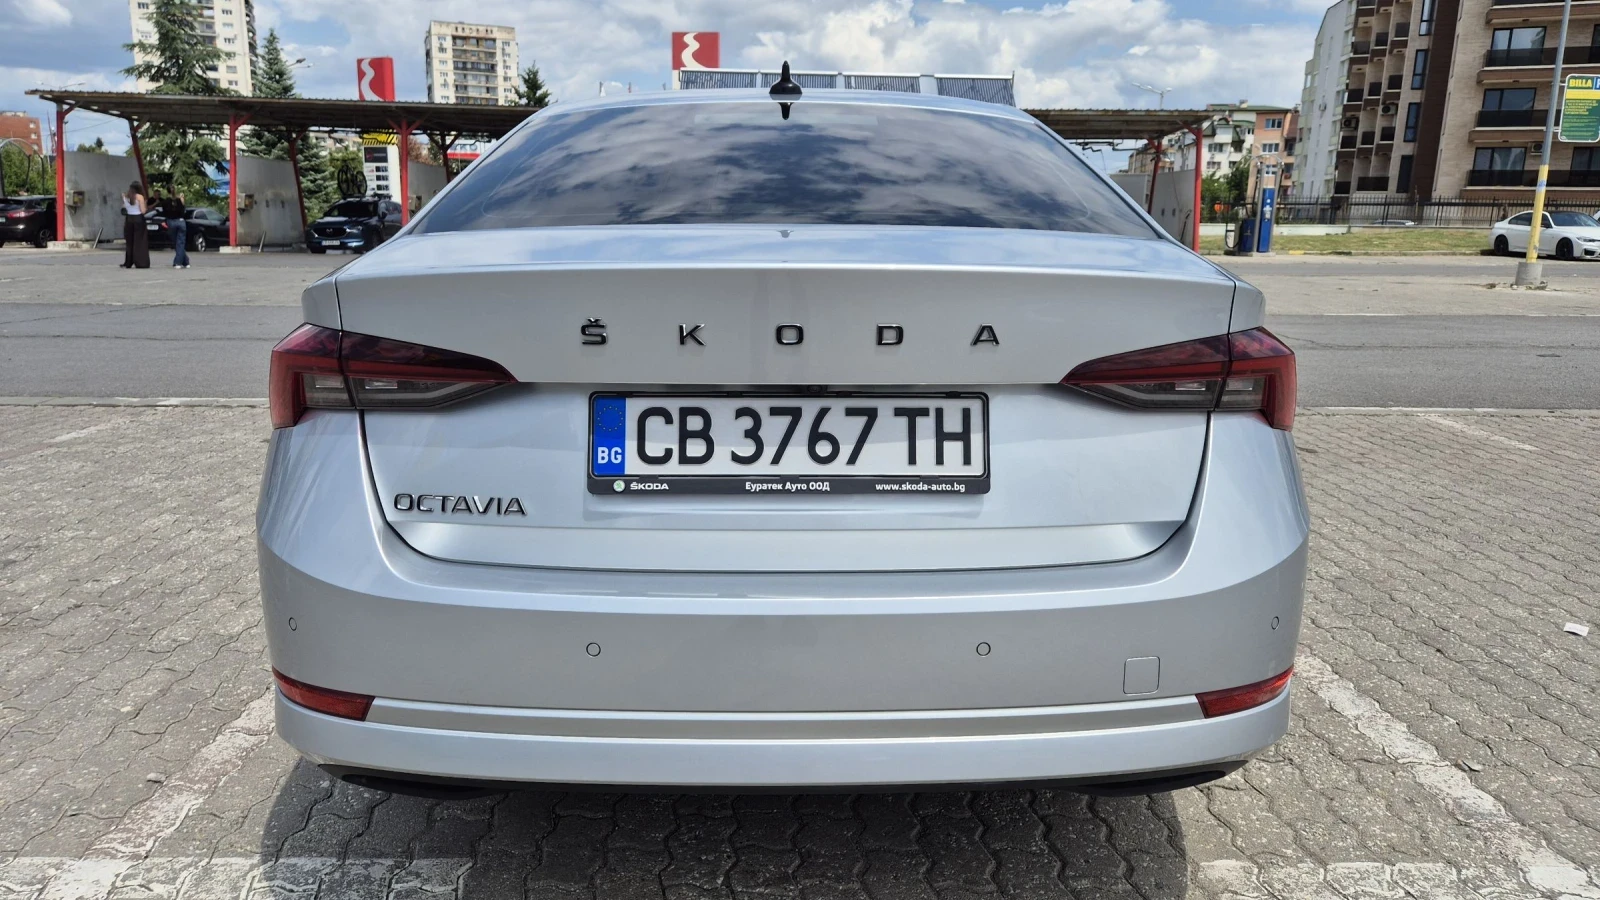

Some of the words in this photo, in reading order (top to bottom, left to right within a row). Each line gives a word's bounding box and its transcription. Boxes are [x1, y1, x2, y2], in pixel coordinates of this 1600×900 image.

[1569, 78, 1593, 88] BILLA
[580, 317, 1000, 347] ŠKODA
[636, 406, 715, 465] CB
[731, 406, 879, 466] 3767
[893, 407, 972, 466] TH
[597, 446, 622, 464] BG
[630, 482, 669, 490] ŠKODA
[745, 482, 783, 492] Еуратек
[785, 482, 808, 492] Ауто
[809, 482, 831, 491] ООД
[875, 482, 966, 492] www.skoda-auto.bg
[393, 493, 527, 516] OCTAVIA
